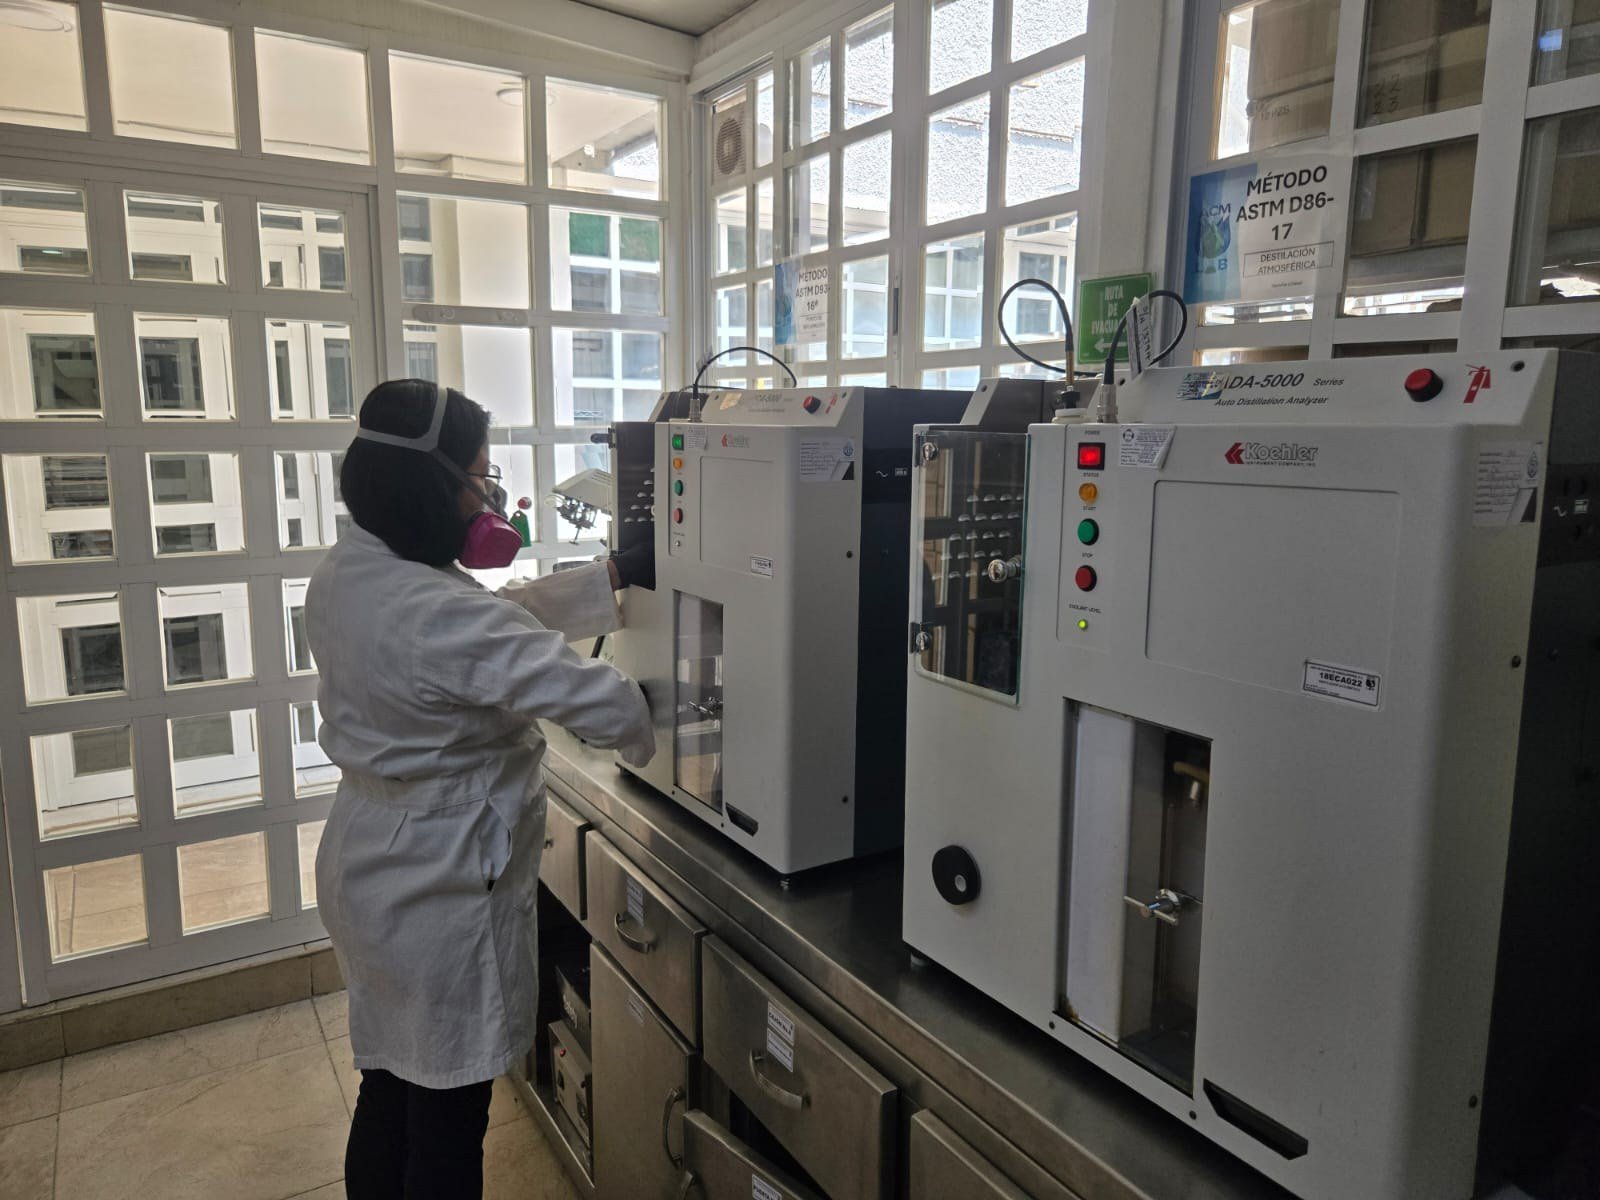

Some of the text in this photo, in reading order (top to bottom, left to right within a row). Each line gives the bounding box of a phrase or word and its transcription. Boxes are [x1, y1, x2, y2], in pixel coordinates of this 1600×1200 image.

[1247, 165, 1328, 196] MÉTODO
[1236, 191, 1335, 222] ASTM D86-
[1271, 222, 1294, 241] 17
[1260, 245, 1316, 263] DESTILACIÓN
[1257, 260, 1316, 275] ATMOSFÉRICA
[795, 285, 814, 298] ASTM
[1313, 377, 1345, 387] Series
[1215, 396, 1329, 407] Auto Distillation Analyzer
[1245, 442, 1319, 461] Koehler
[1319, 672, 1363, 688] 18ECA022
